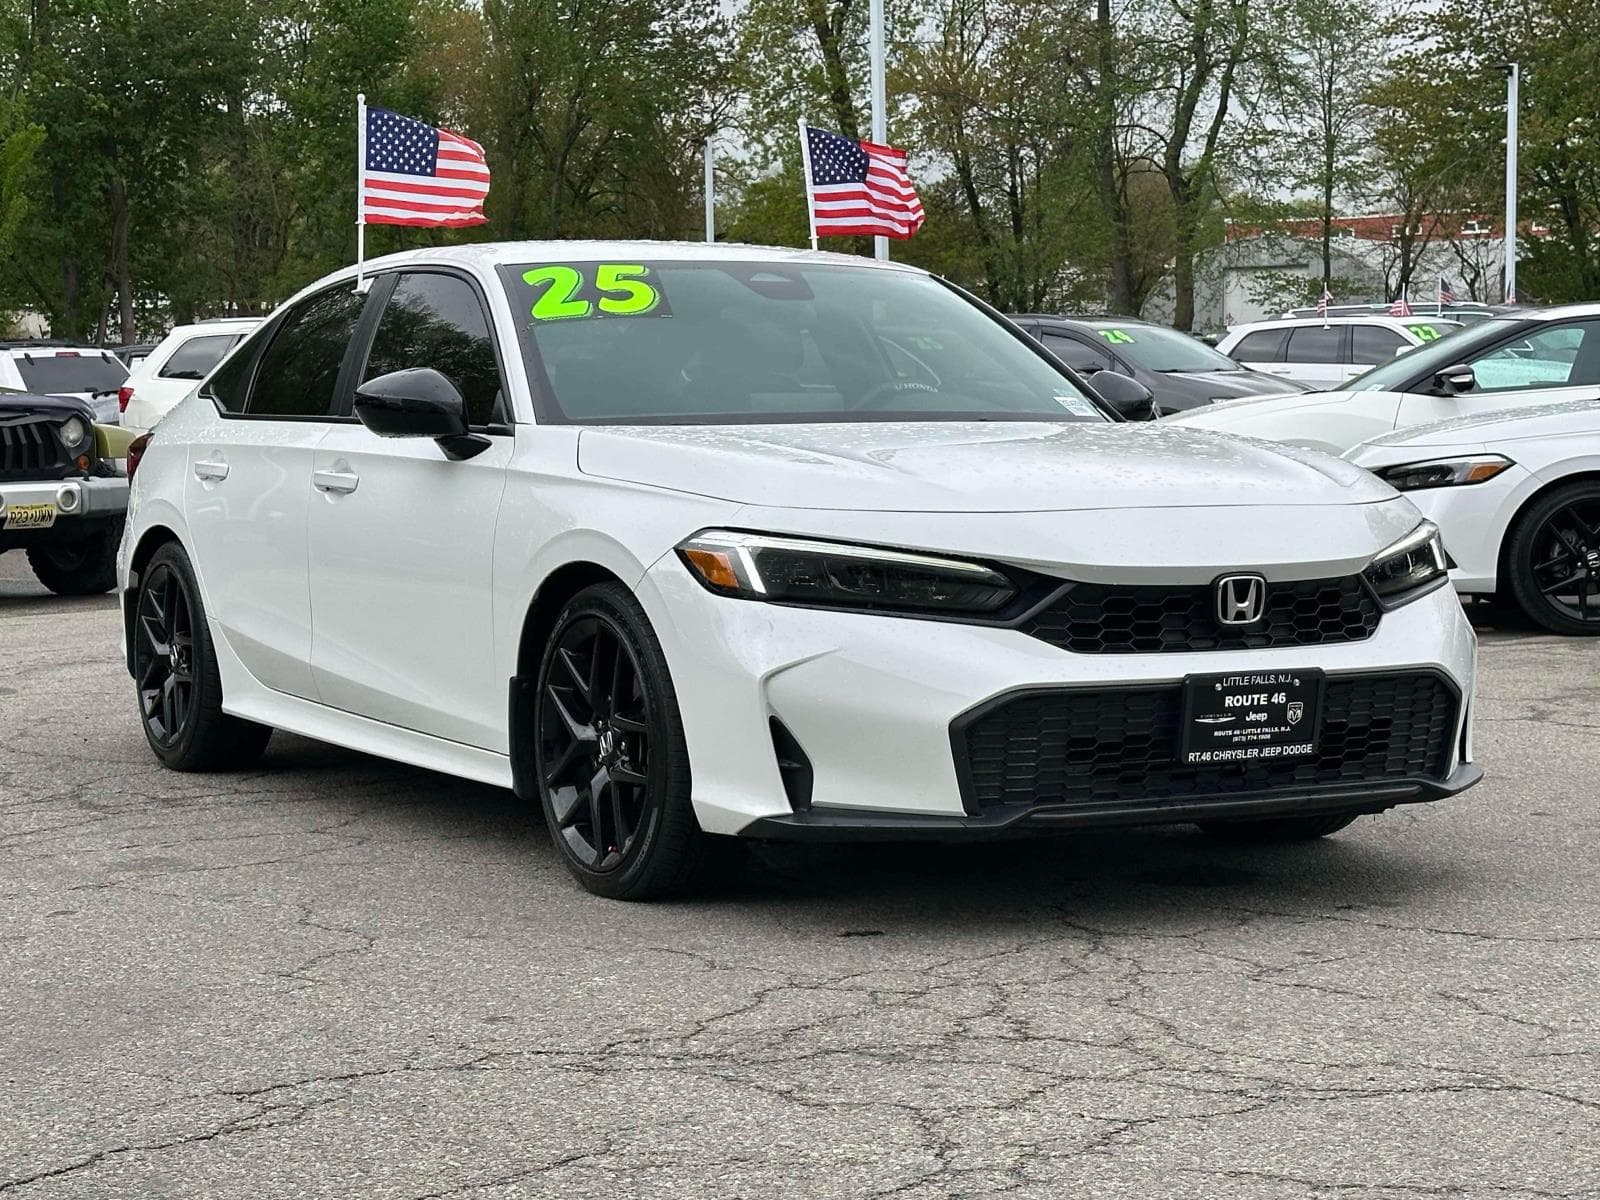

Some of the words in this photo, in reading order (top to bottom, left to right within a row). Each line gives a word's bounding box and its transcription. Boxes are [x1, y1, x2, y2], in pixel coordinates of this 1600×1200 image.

[522, 263, 660, 321] 25
[1097, 329, 1136, 344] 24
[1222, 676, 1250, 687] LITTLE
[1251, 674, 1277, 685] FALLS,
[1224, 693, 1269, 708] ROUTE
[1270, 692, 1287, 705] 46
[1245, 711, 1268, 722] Jeep
[1188, 751, 1212, 762] RT.46
[1212, 748, 1259, 761] CHRYSLER
[1260, 746, 1282, 757] JEEP
[1282, 743, 1313, 755] DODGE
